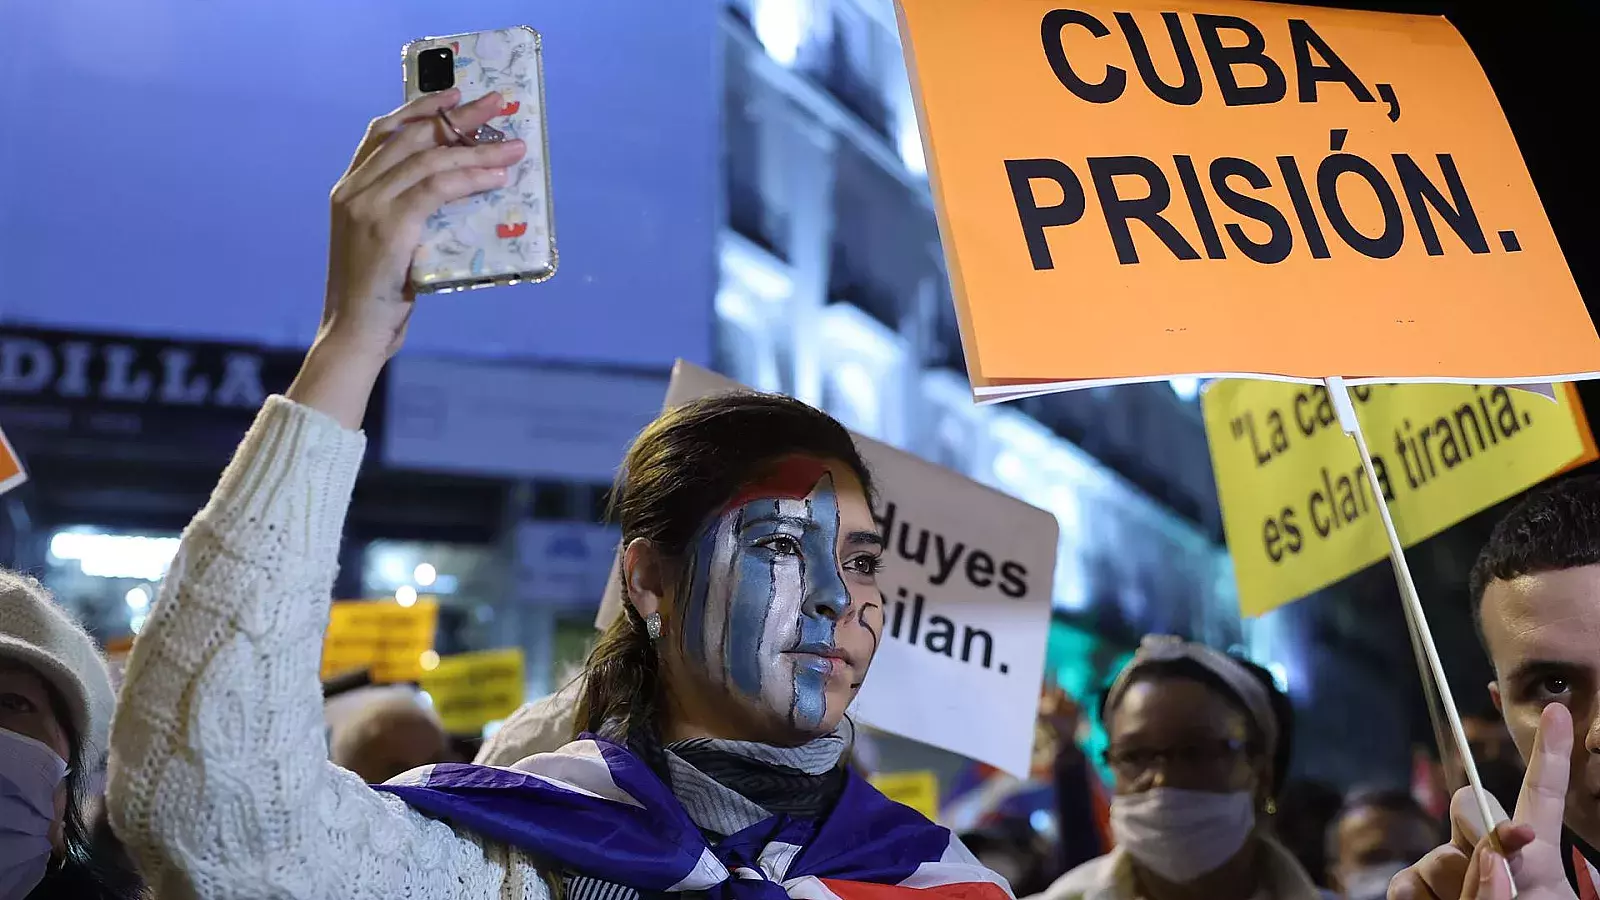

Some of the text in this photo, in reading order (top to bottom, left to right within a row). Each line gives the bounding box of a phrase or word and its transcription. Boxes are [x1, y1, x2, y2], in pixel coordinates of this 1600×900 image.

[1040, 8, 1401, 123] CUBA,
[1004, 129, 1522, 271] PRISIÓN.
[1229, 409, 1290, 467] "La
[873, 501, 1029, 599] Huyes
[1263, 505, 1303, 563] es
